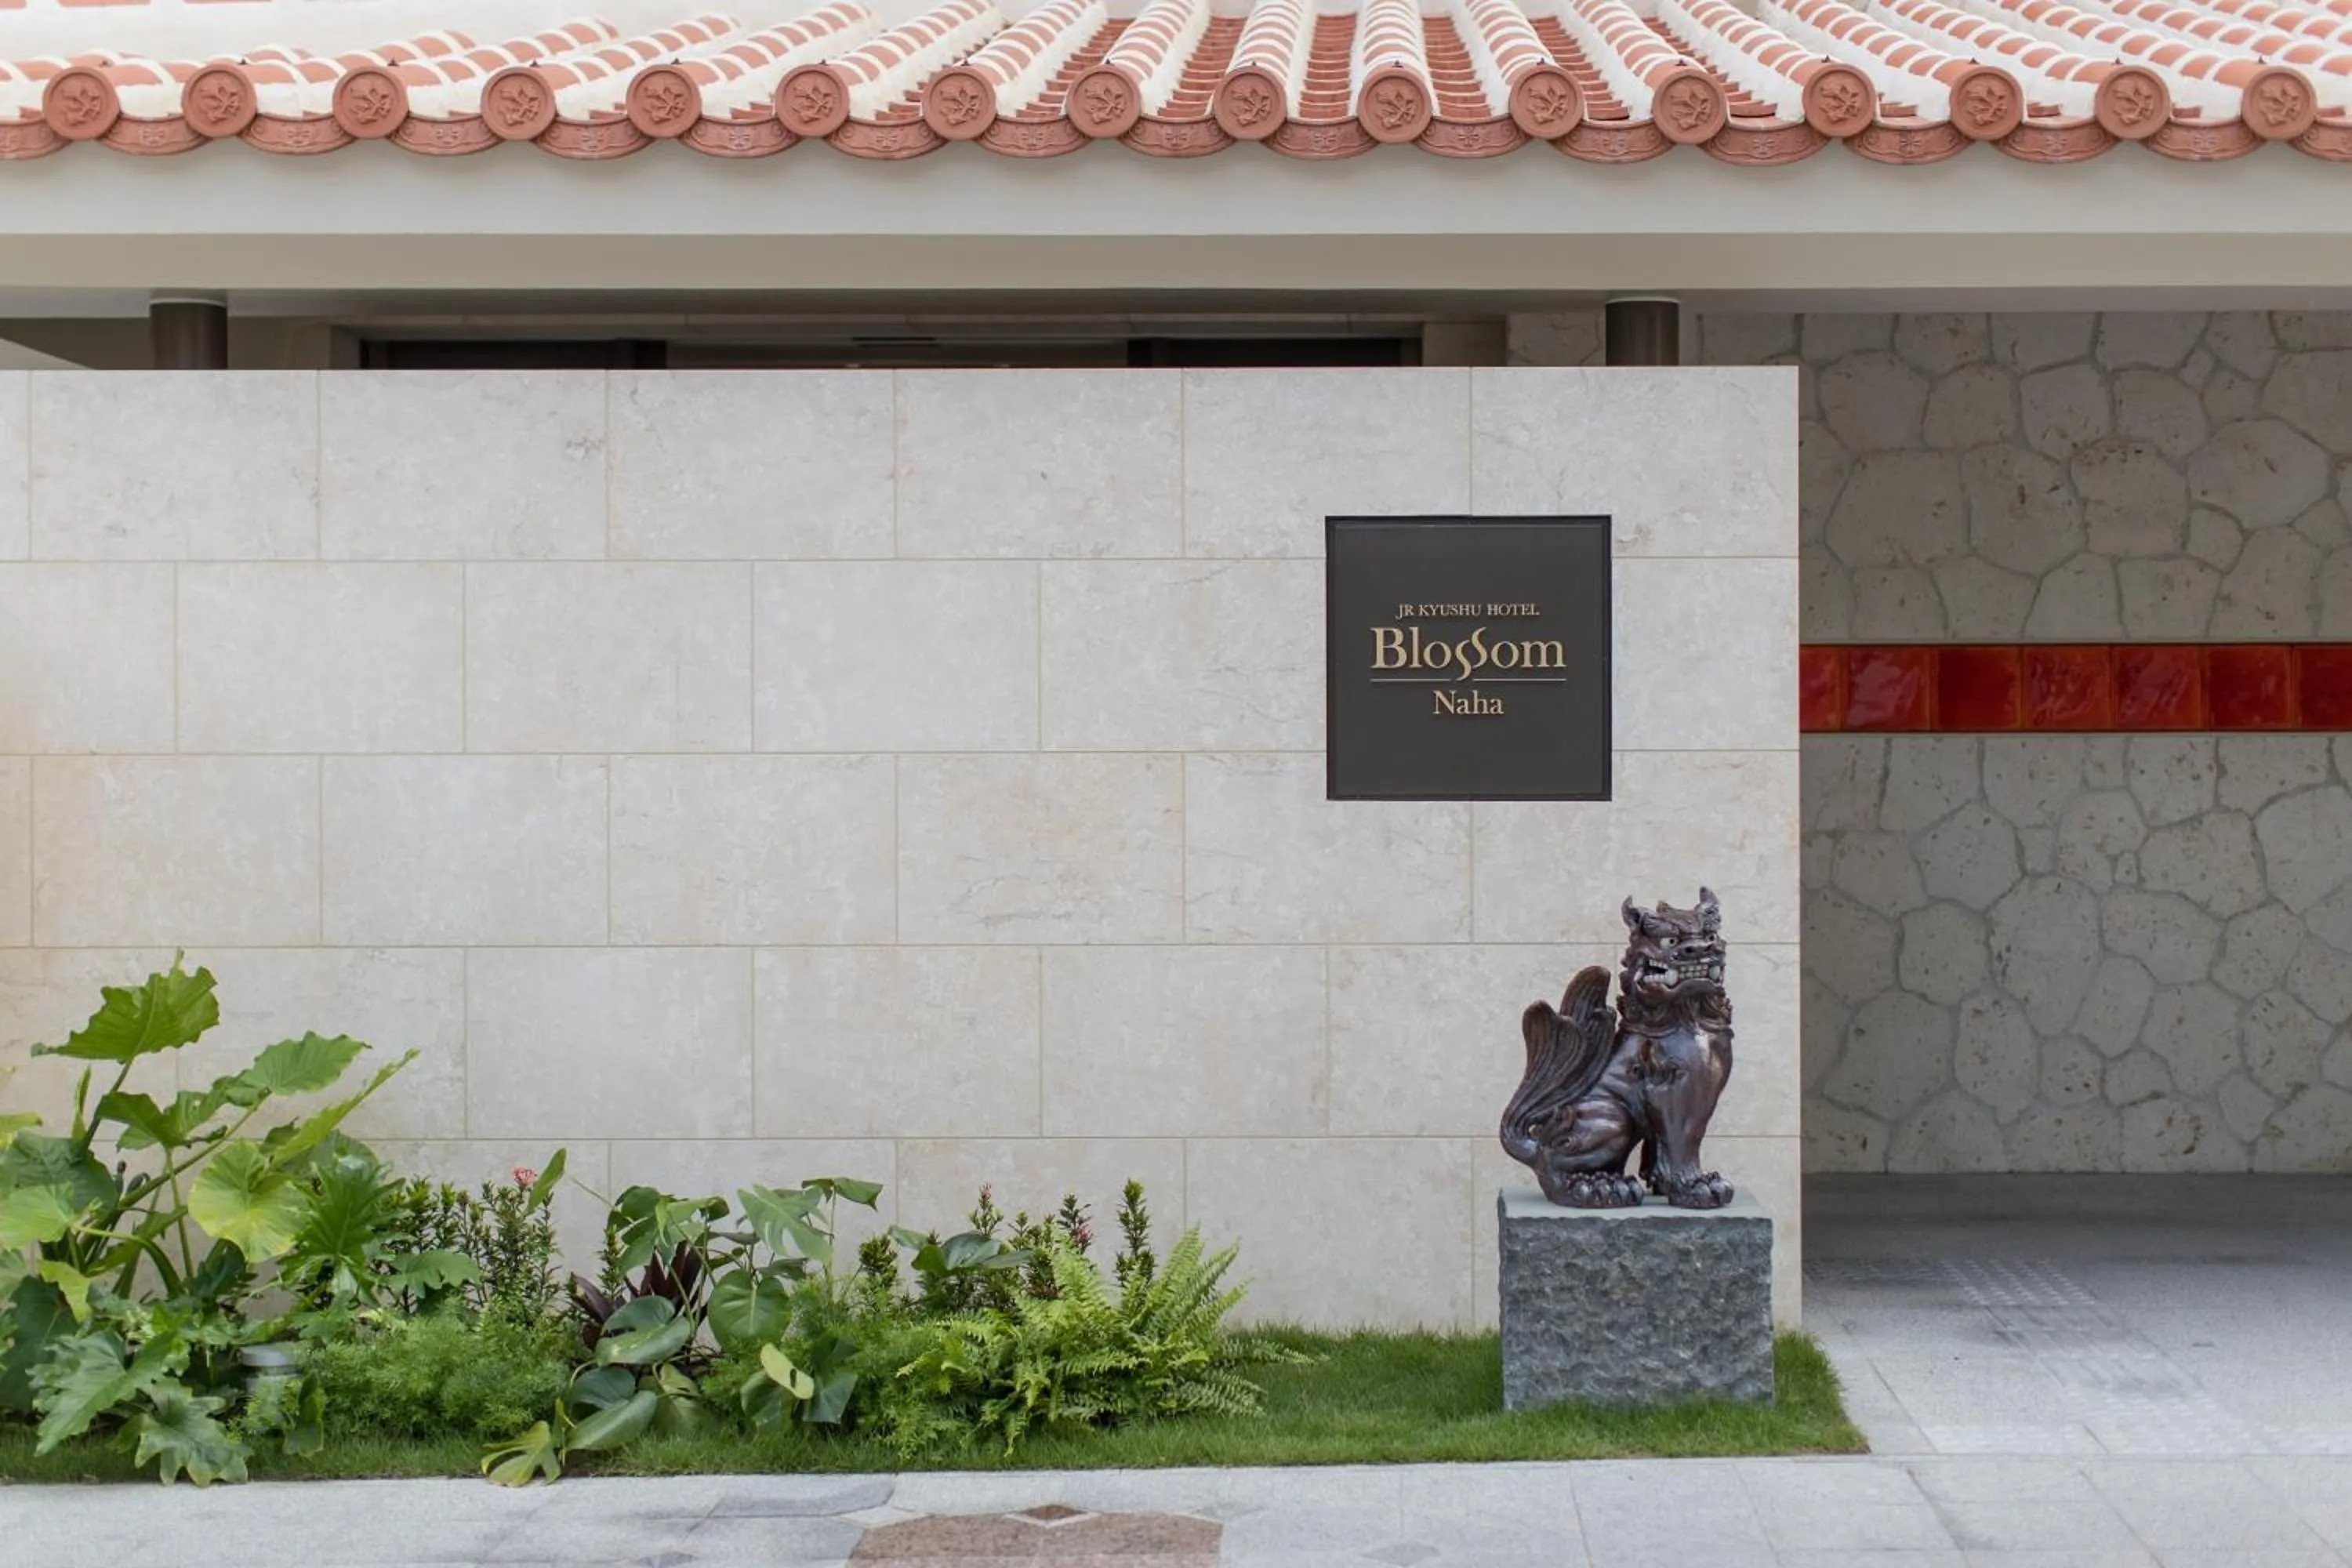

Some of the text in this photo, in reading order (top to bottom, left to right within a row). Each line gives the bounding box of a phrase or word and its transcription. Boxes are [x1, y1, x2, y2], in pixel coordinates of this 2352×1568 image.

[1396, 604, 1540, 620] JR KYUSHU HOTEL
[1370, 626, 1566, 681] Blossom
[1433, 690, 1504, 715] Naha
